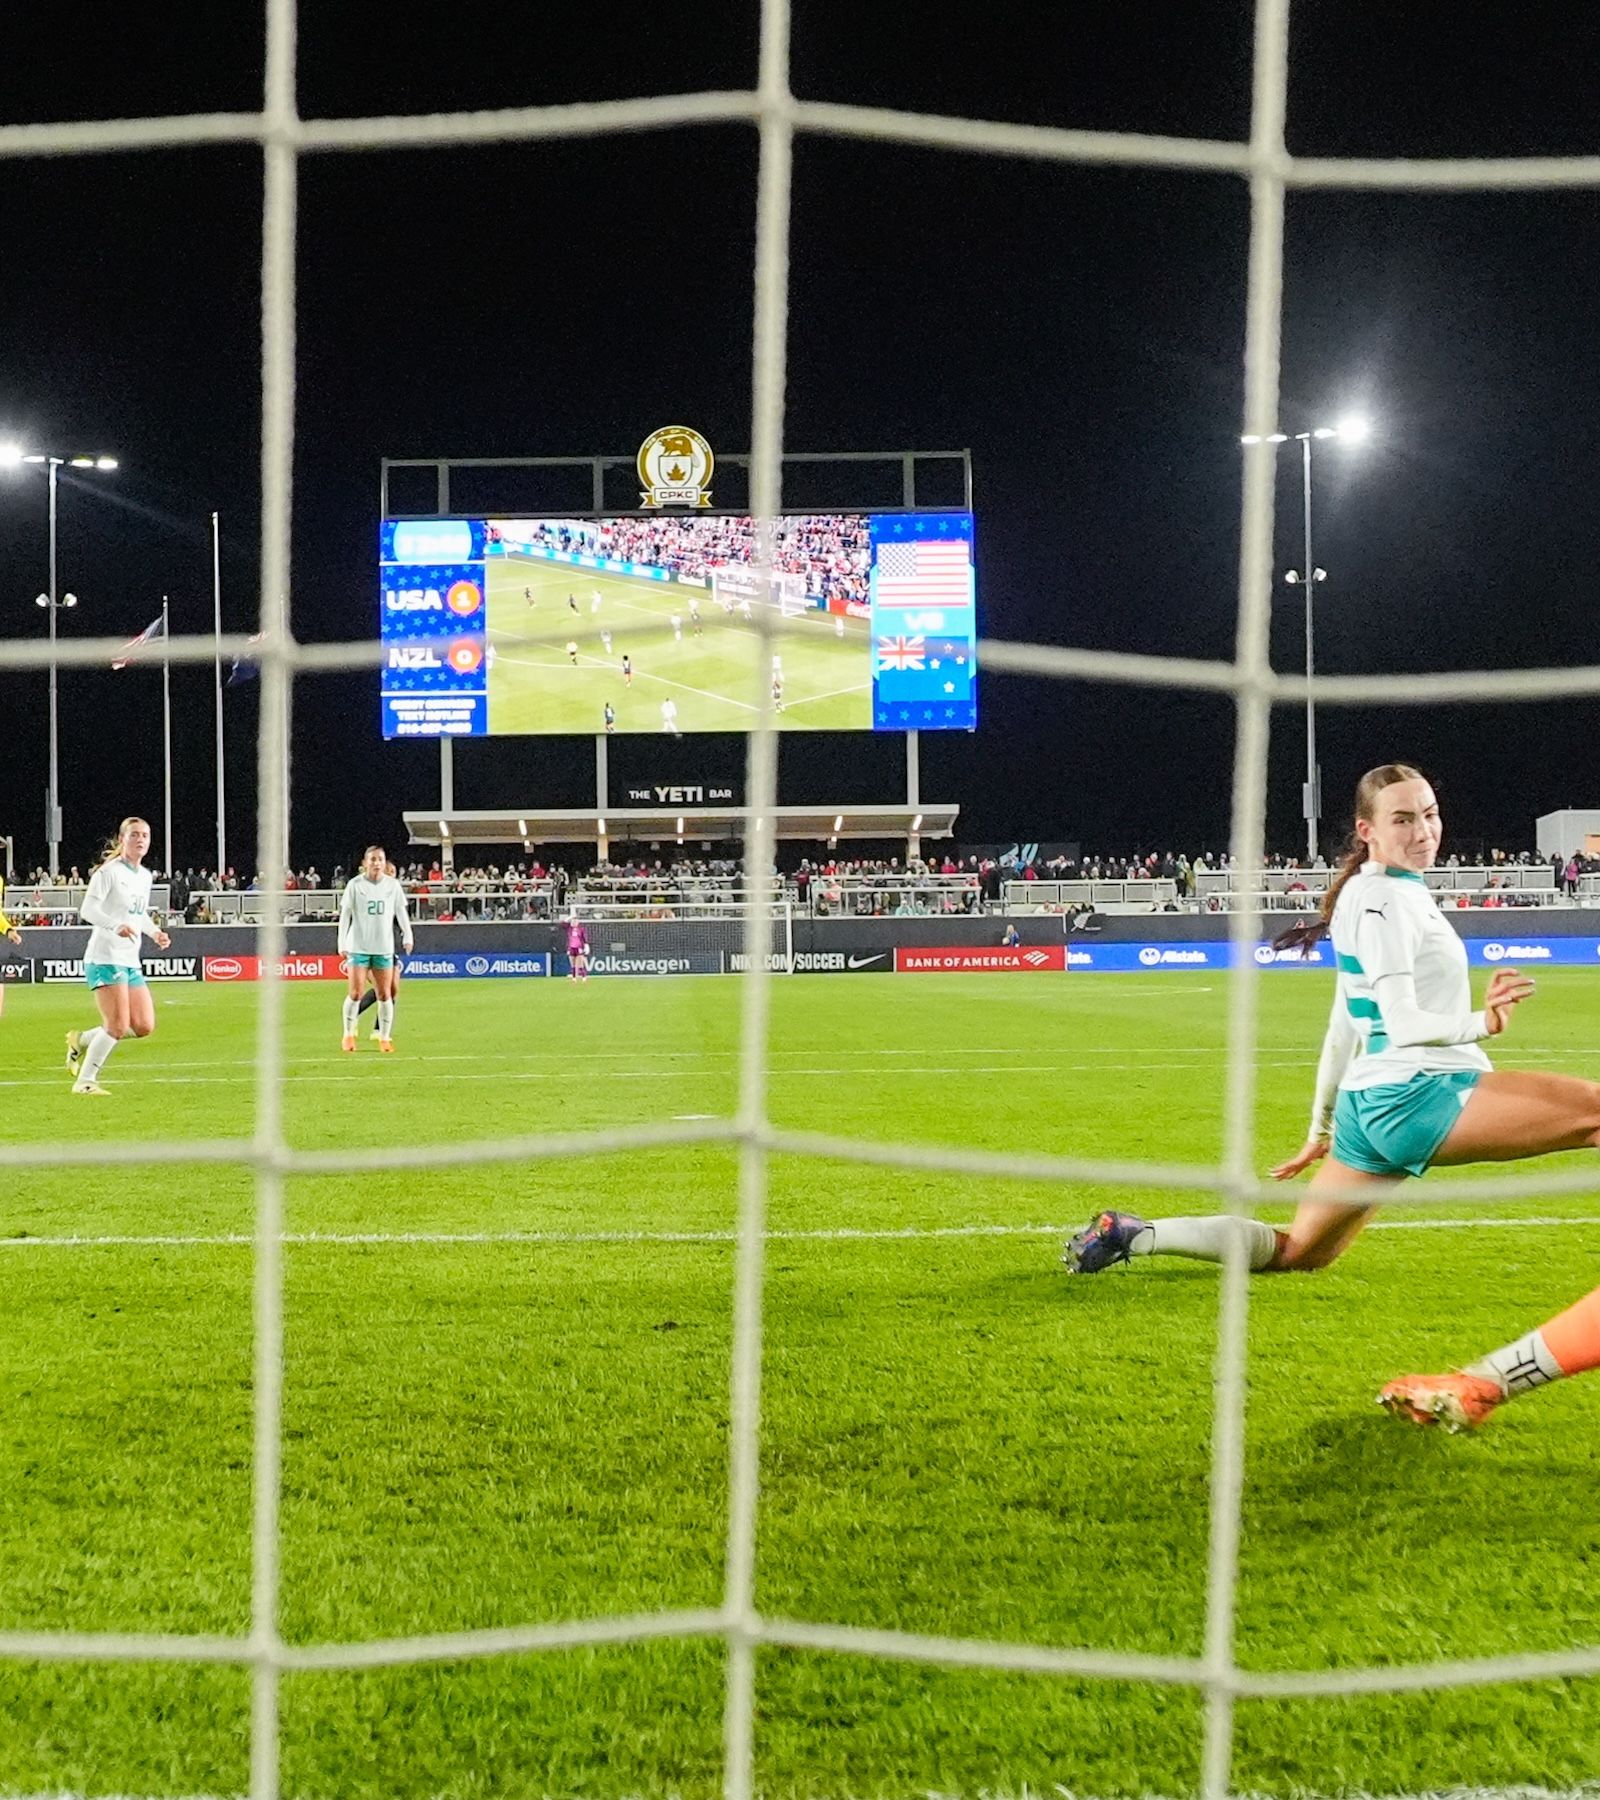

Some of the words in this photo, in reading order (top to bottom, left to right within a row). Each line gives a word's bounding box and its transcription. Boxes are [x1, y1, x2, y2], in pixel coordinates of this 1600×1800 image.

[660, 491, 693, 499] CPKC
[386, 589, 442, 611] USA
[456, 590, 471, 608] 1
[389, 647, 442, 669] NZL
[456, 649, 473, 666] 0
[628, 790, 650, 800] THE
[654, 786, 703, 802] YETI
[709, 789, 732, 799] BAR
[128, 894, 145, 915] 30
[367, 900, 385, 916] 20
[43, 959, 86, 977] TRUL
[142, 958, 197, 977] TRULY
[209, 964, 239, 974] Henkel
[404, 960, 456, 974] Allstate
[489, 958, 541, 973] Allstate
[584, 956, 690, 974] Volkswagen
[906, 957, 941, 968] BANK
[944, 957, 959, 968] OF
[963, 956, 1021, 967] AMERICA
